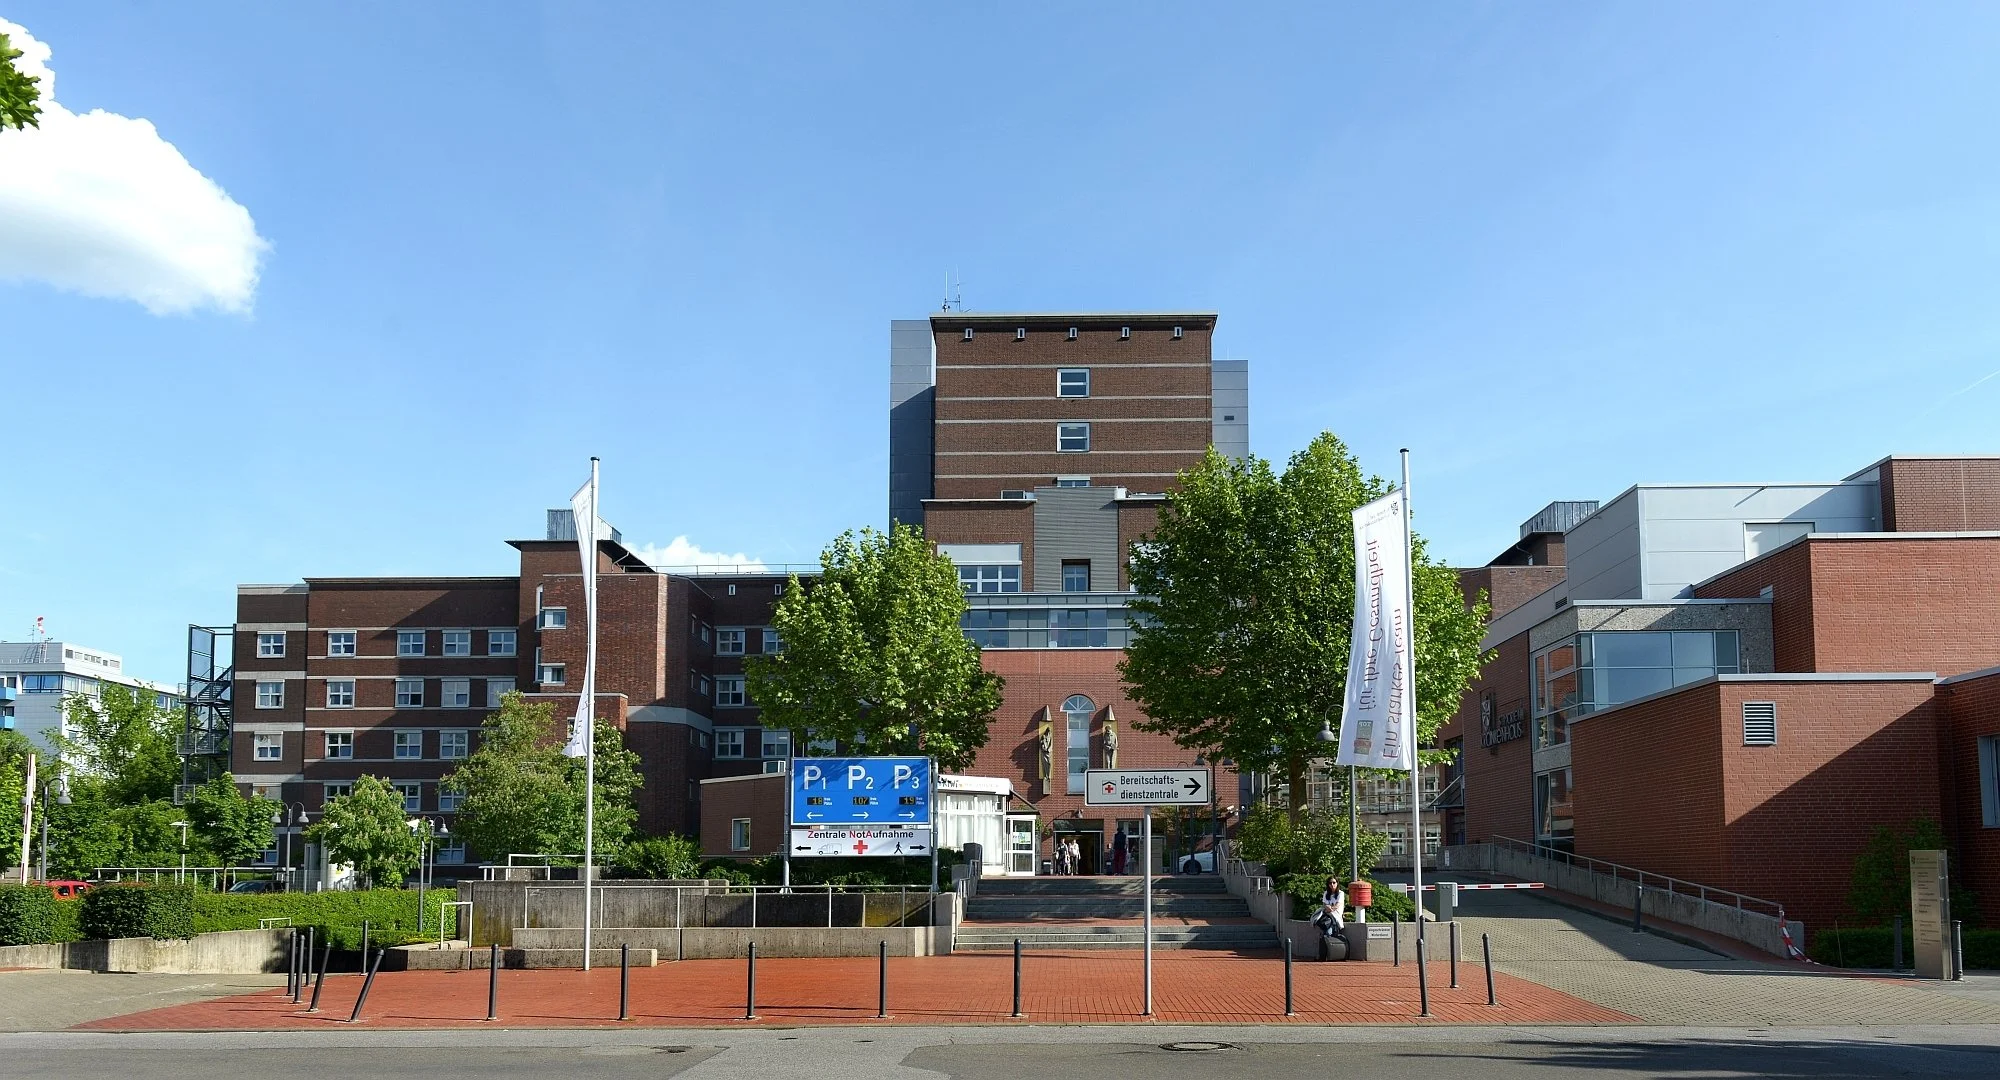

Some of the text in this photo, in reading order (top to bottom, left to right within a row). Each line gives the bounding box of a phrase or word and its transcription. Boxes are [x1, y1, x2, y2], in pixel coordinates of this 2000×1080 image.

[1120, 774, 1180, 785] Bereitschafts-
[1120, 789, 1179, 799] dienstzentrale
[812, 797, 823, 805] 18
[853, 797, 868, 805] 107
[904, 796, 915, 805] 19
[807, 830, 914, 839] Zentrale NotAufnahme
